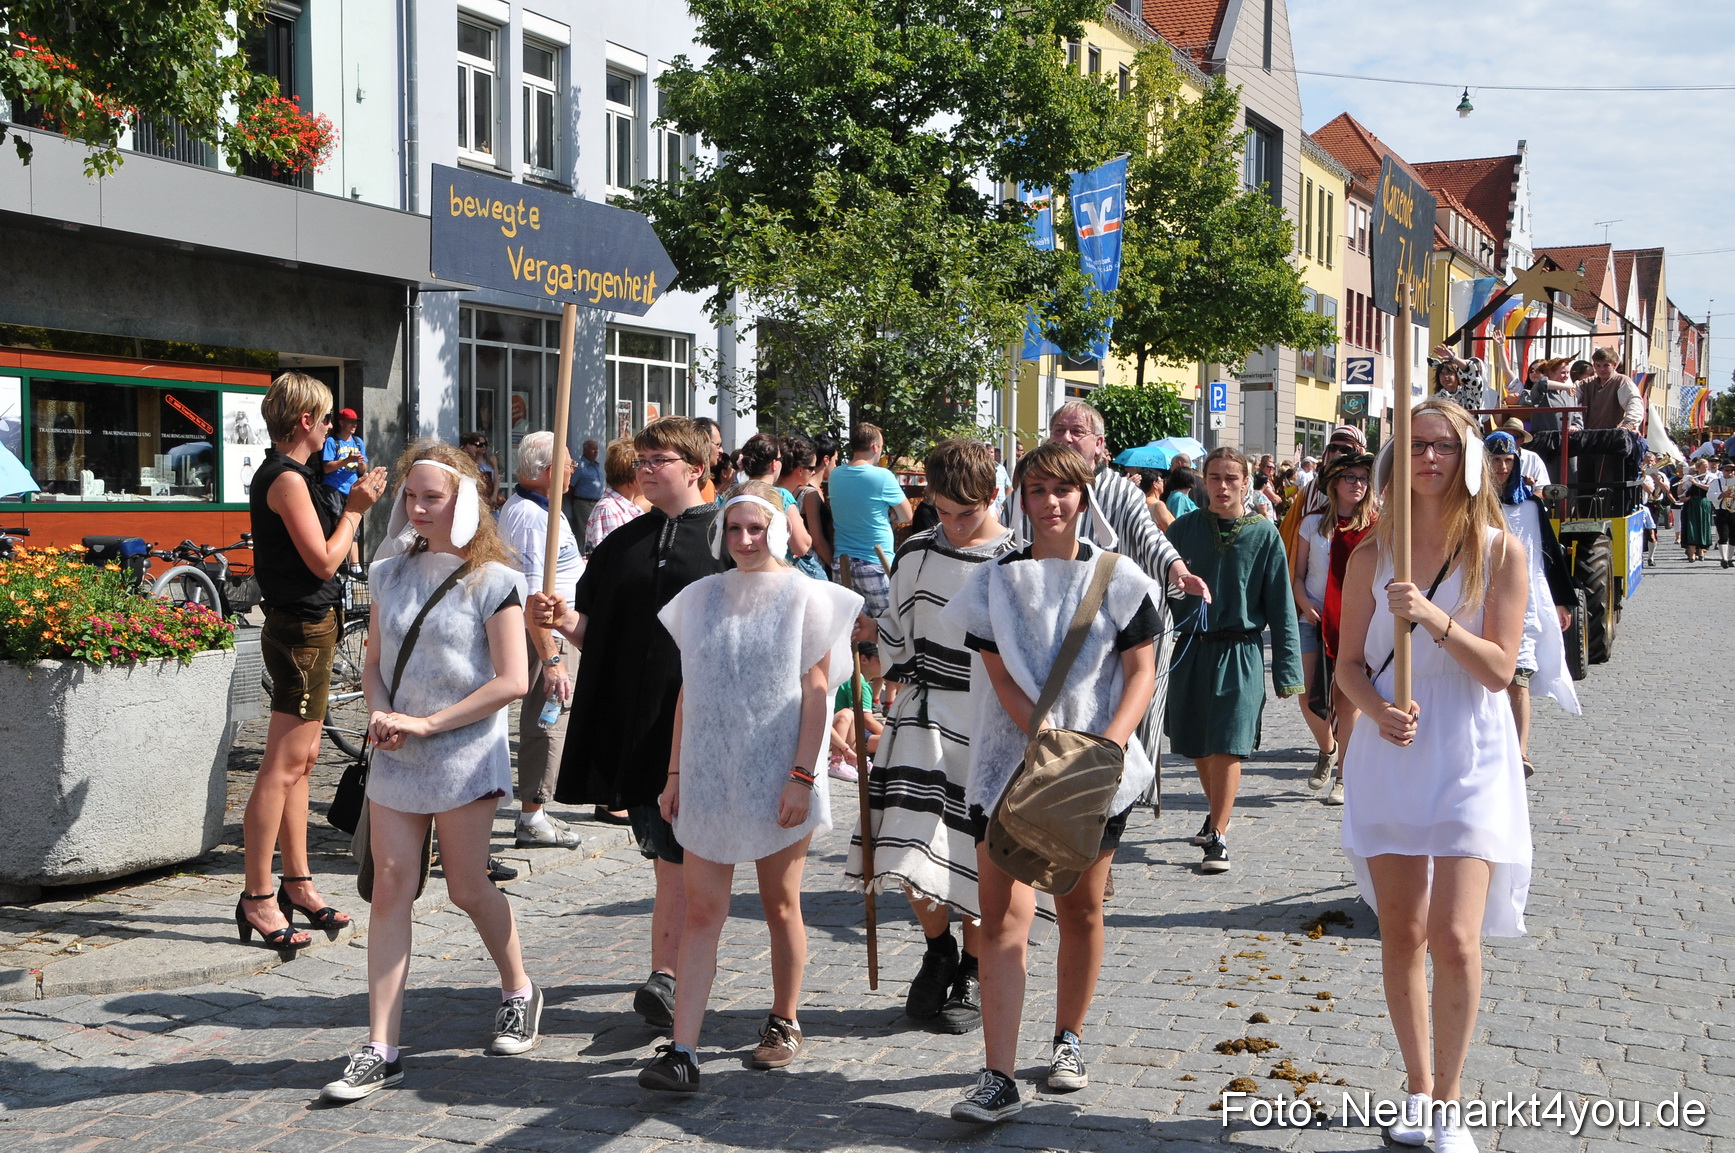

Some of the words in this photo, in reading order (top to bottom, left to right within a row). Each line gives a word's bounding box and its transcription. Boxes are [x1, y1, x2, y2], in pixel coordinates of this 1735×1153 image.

[449, 184, 541, 238] bewegte
[507, 245, 658, 305] Vergangenheit
[1213, 386, 1223, 409] P
[39, 427, 92, 435] TRAURINGAUSSTELLUNG
[102, 430, 151, 438] TRAURINGAUSSTELLUNG
